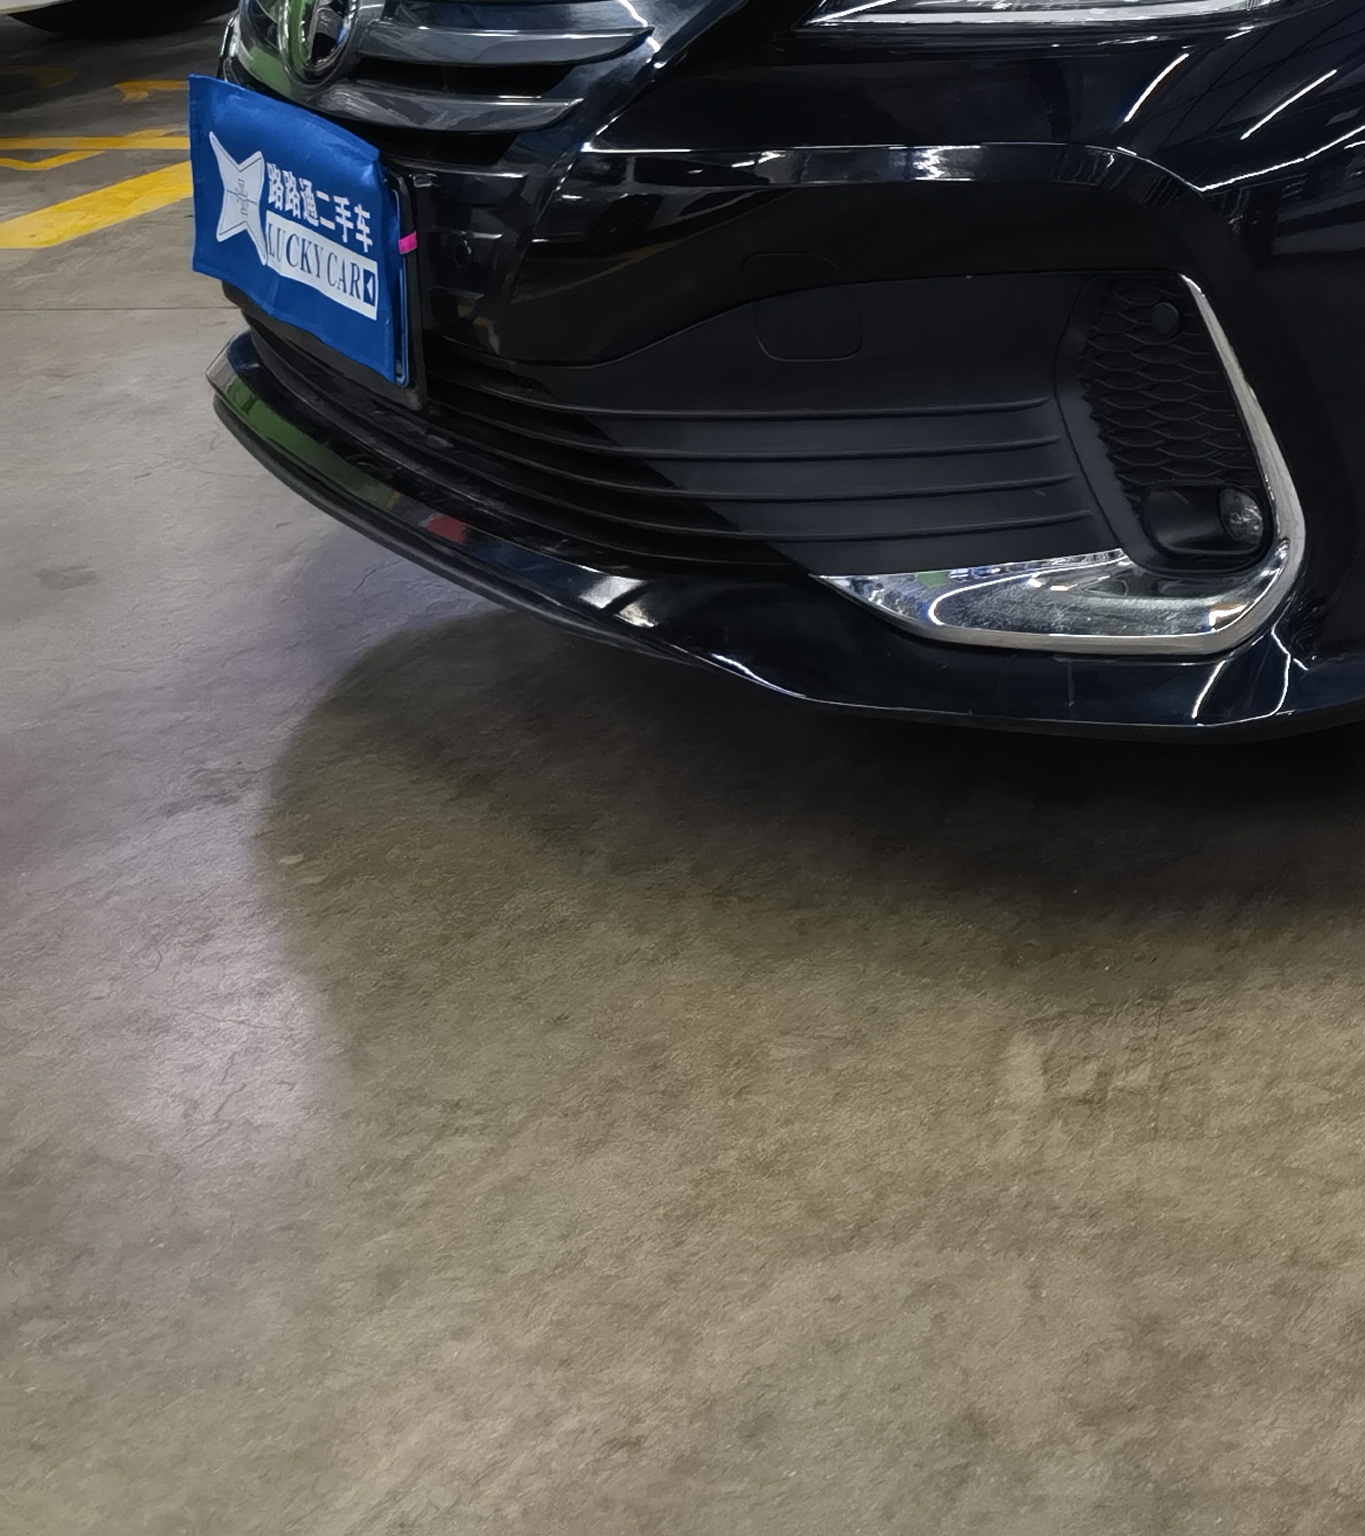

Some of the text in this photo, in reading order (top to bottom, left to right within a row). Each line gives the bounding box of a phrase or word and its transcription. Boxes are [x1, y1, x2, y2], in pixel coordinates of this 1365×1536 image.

[266, 161, 374, 253] 路路通二手车
[268, 222, 362, 301] LUCKY CAR
